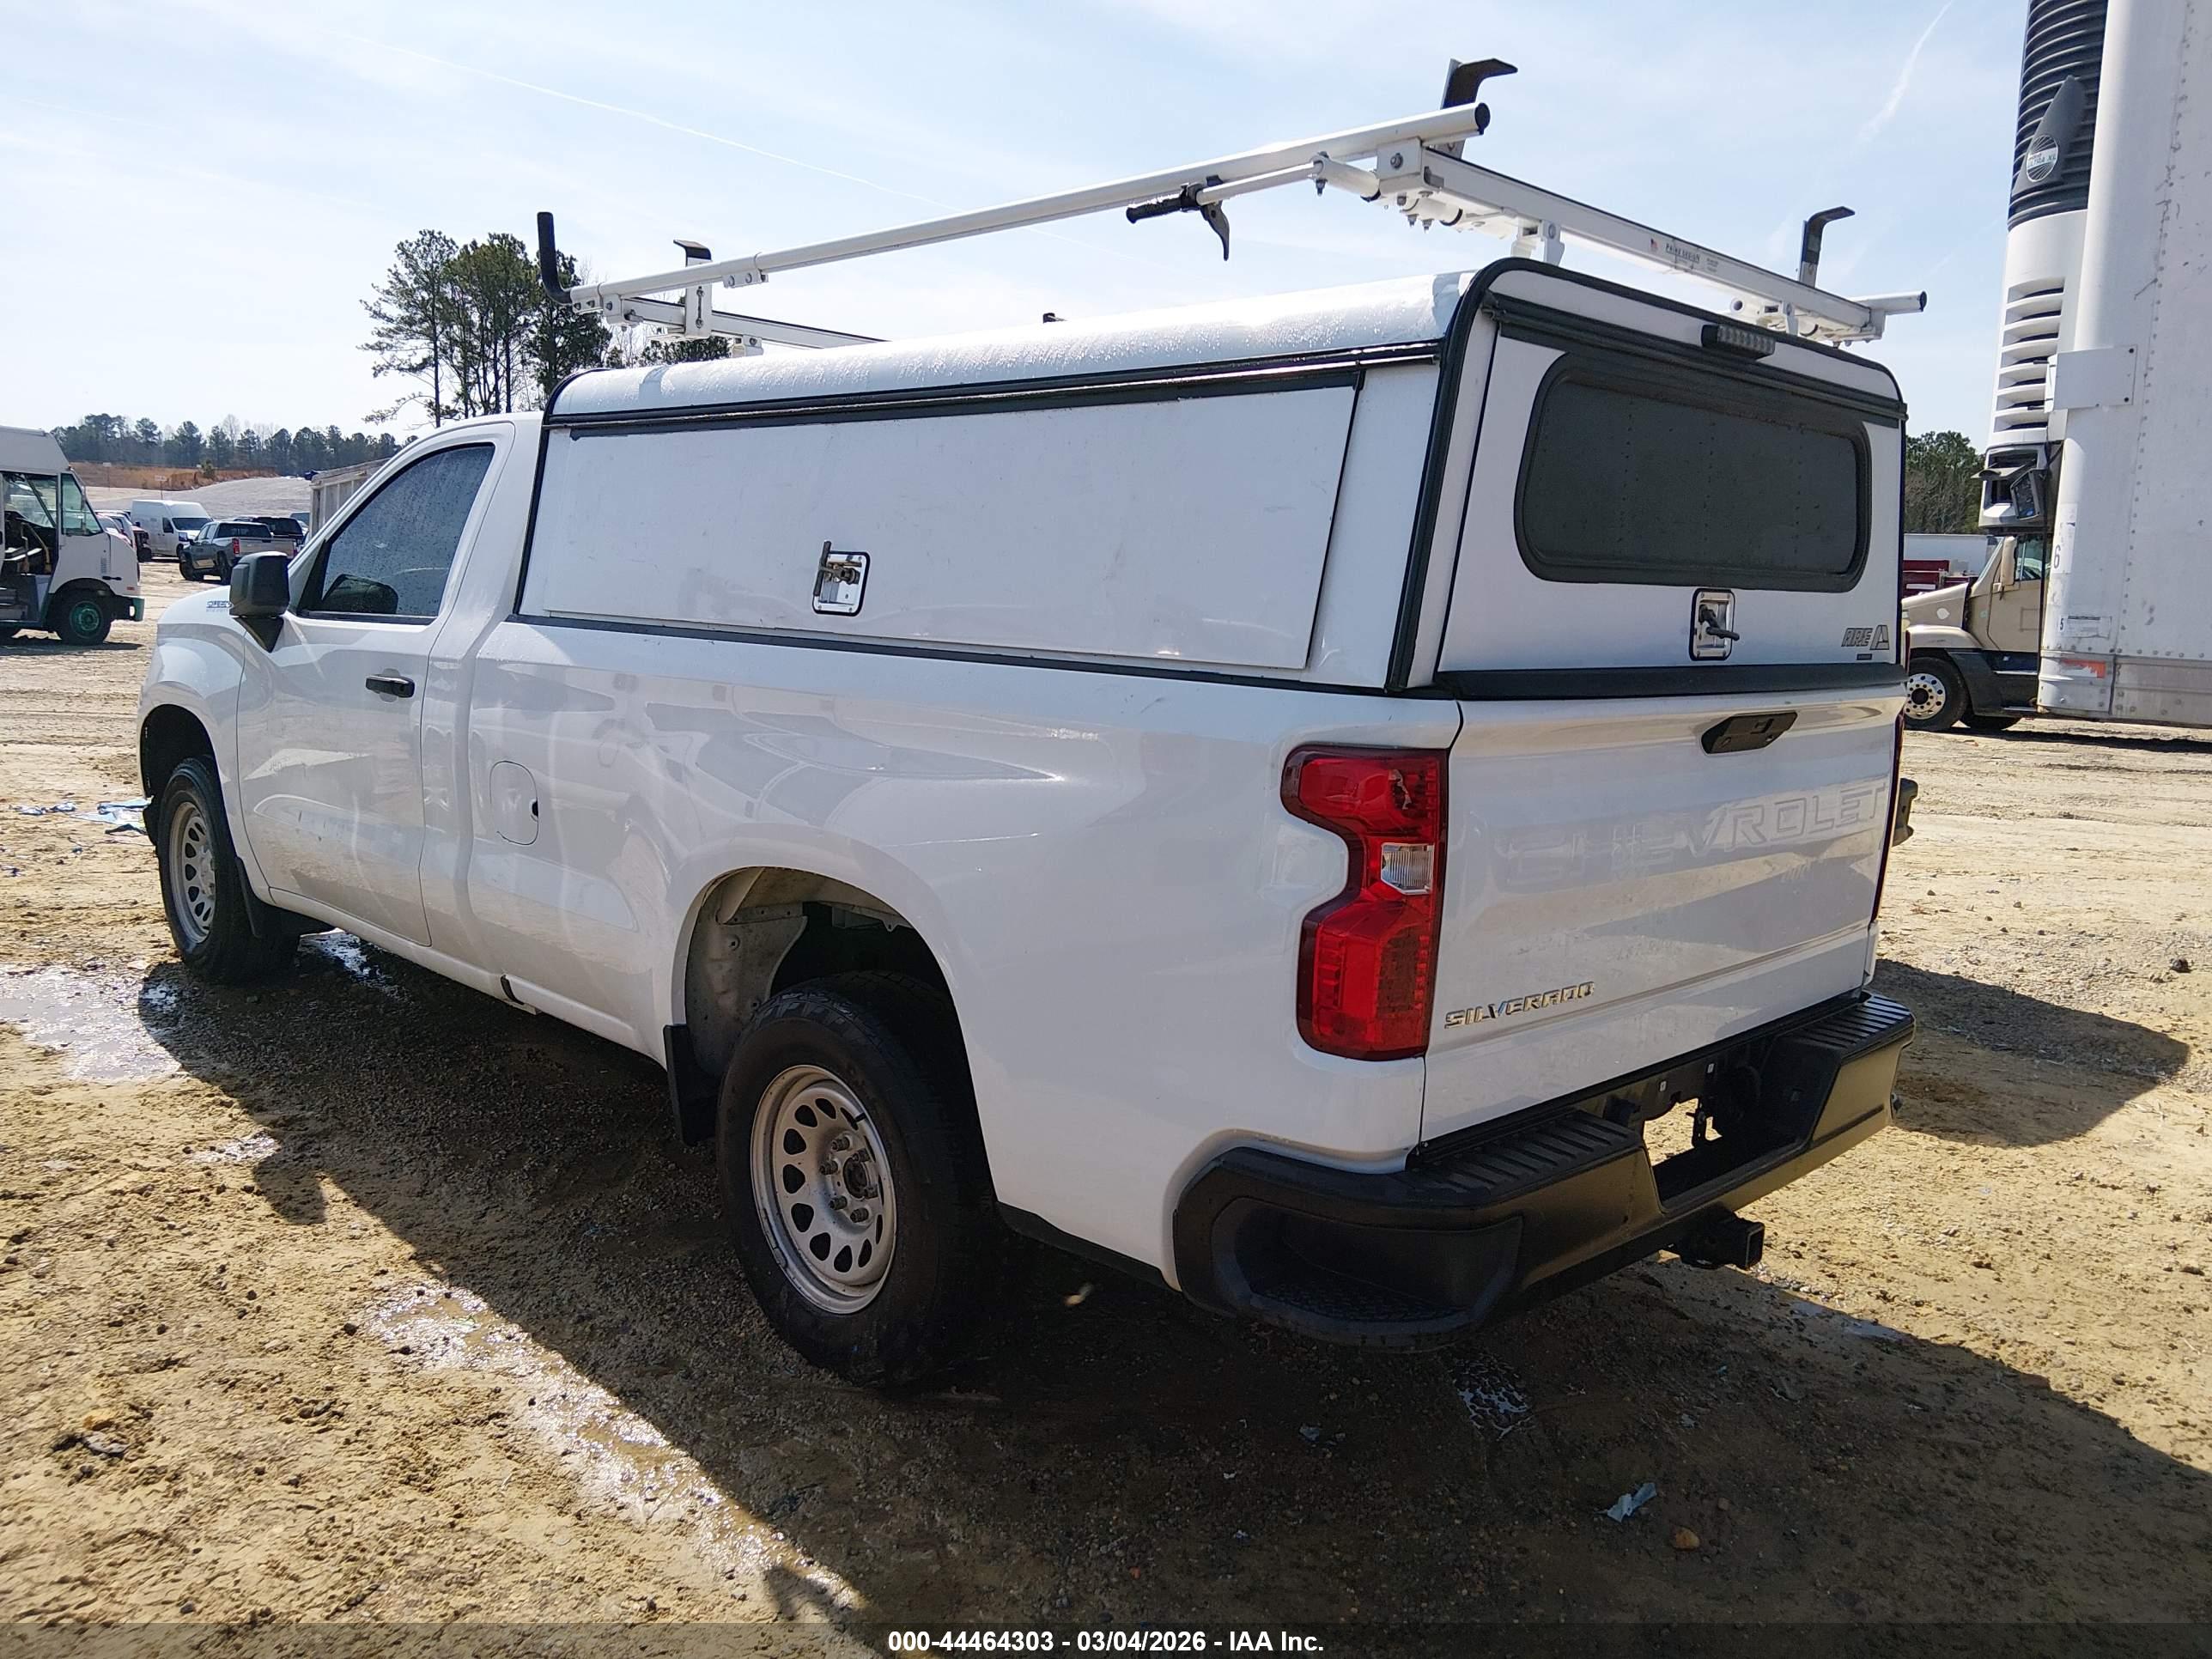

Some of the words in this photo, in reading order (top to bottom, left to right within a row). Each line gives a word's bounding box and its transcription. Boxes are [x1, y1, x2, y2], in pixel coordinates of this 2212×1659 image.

[1841, 627, 1873, 647] ARE
[1506, 781, 1887, 886] CHEVROLET
[1444, 981, 1595, 1029] SILVERADO
